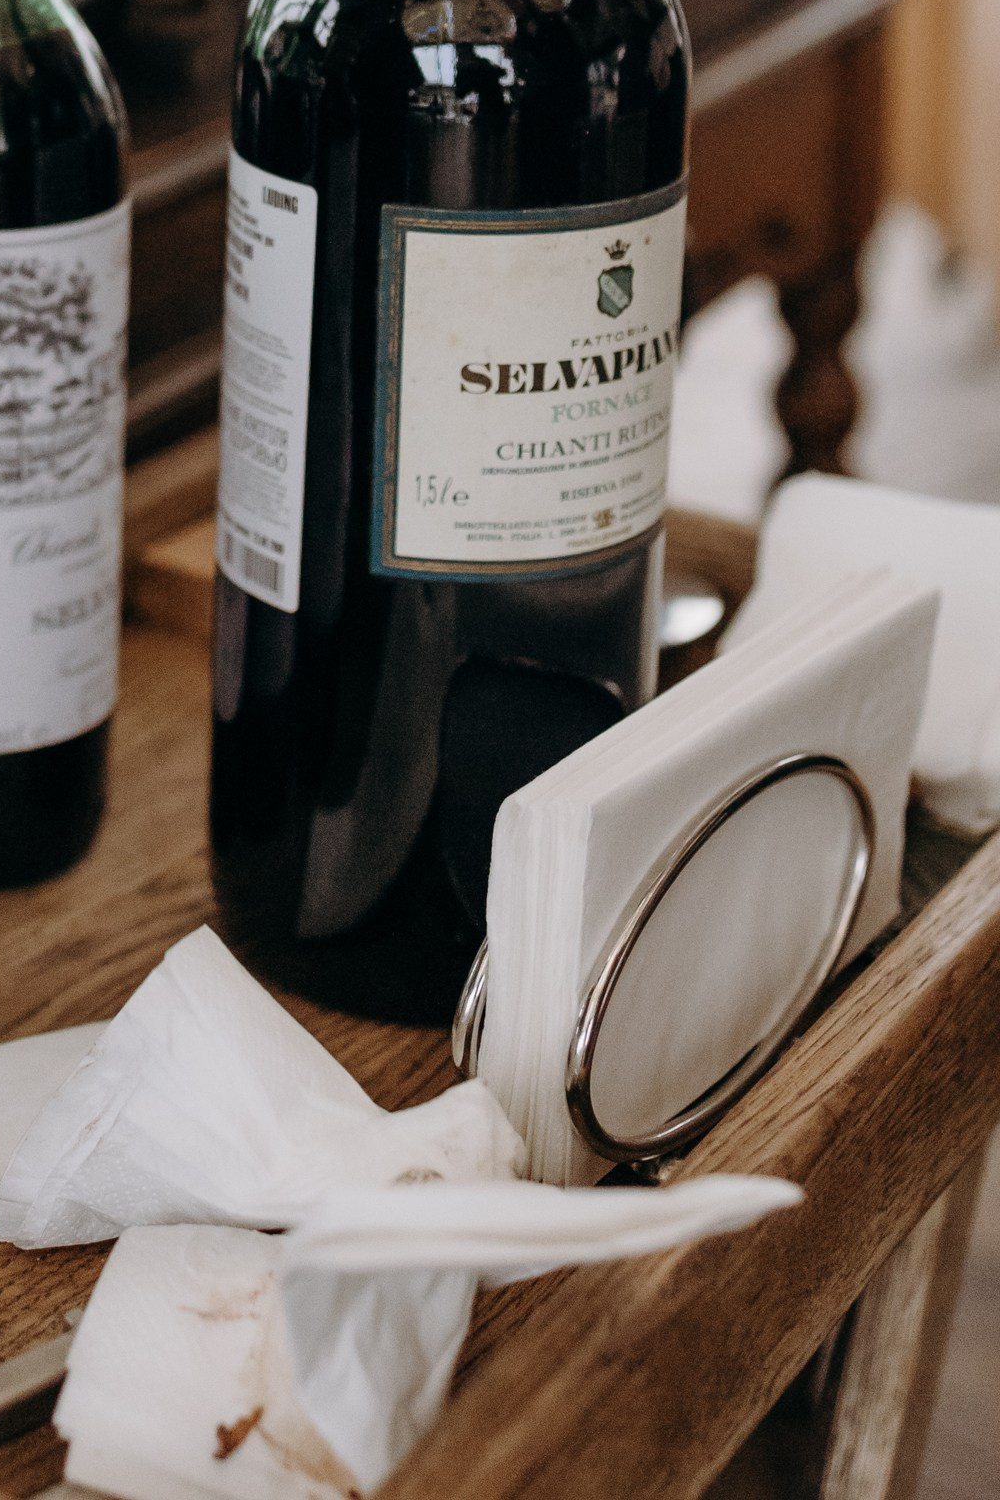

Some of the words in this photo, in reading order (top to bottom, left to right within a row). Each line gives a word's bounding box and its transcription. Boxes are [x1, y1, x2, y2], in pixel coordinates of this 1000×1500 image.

[263, 185, 299, 215] LUDING
[572, 325, 649, 347] FATTORIA
[496, 431, 613, 461] CHIANTI
